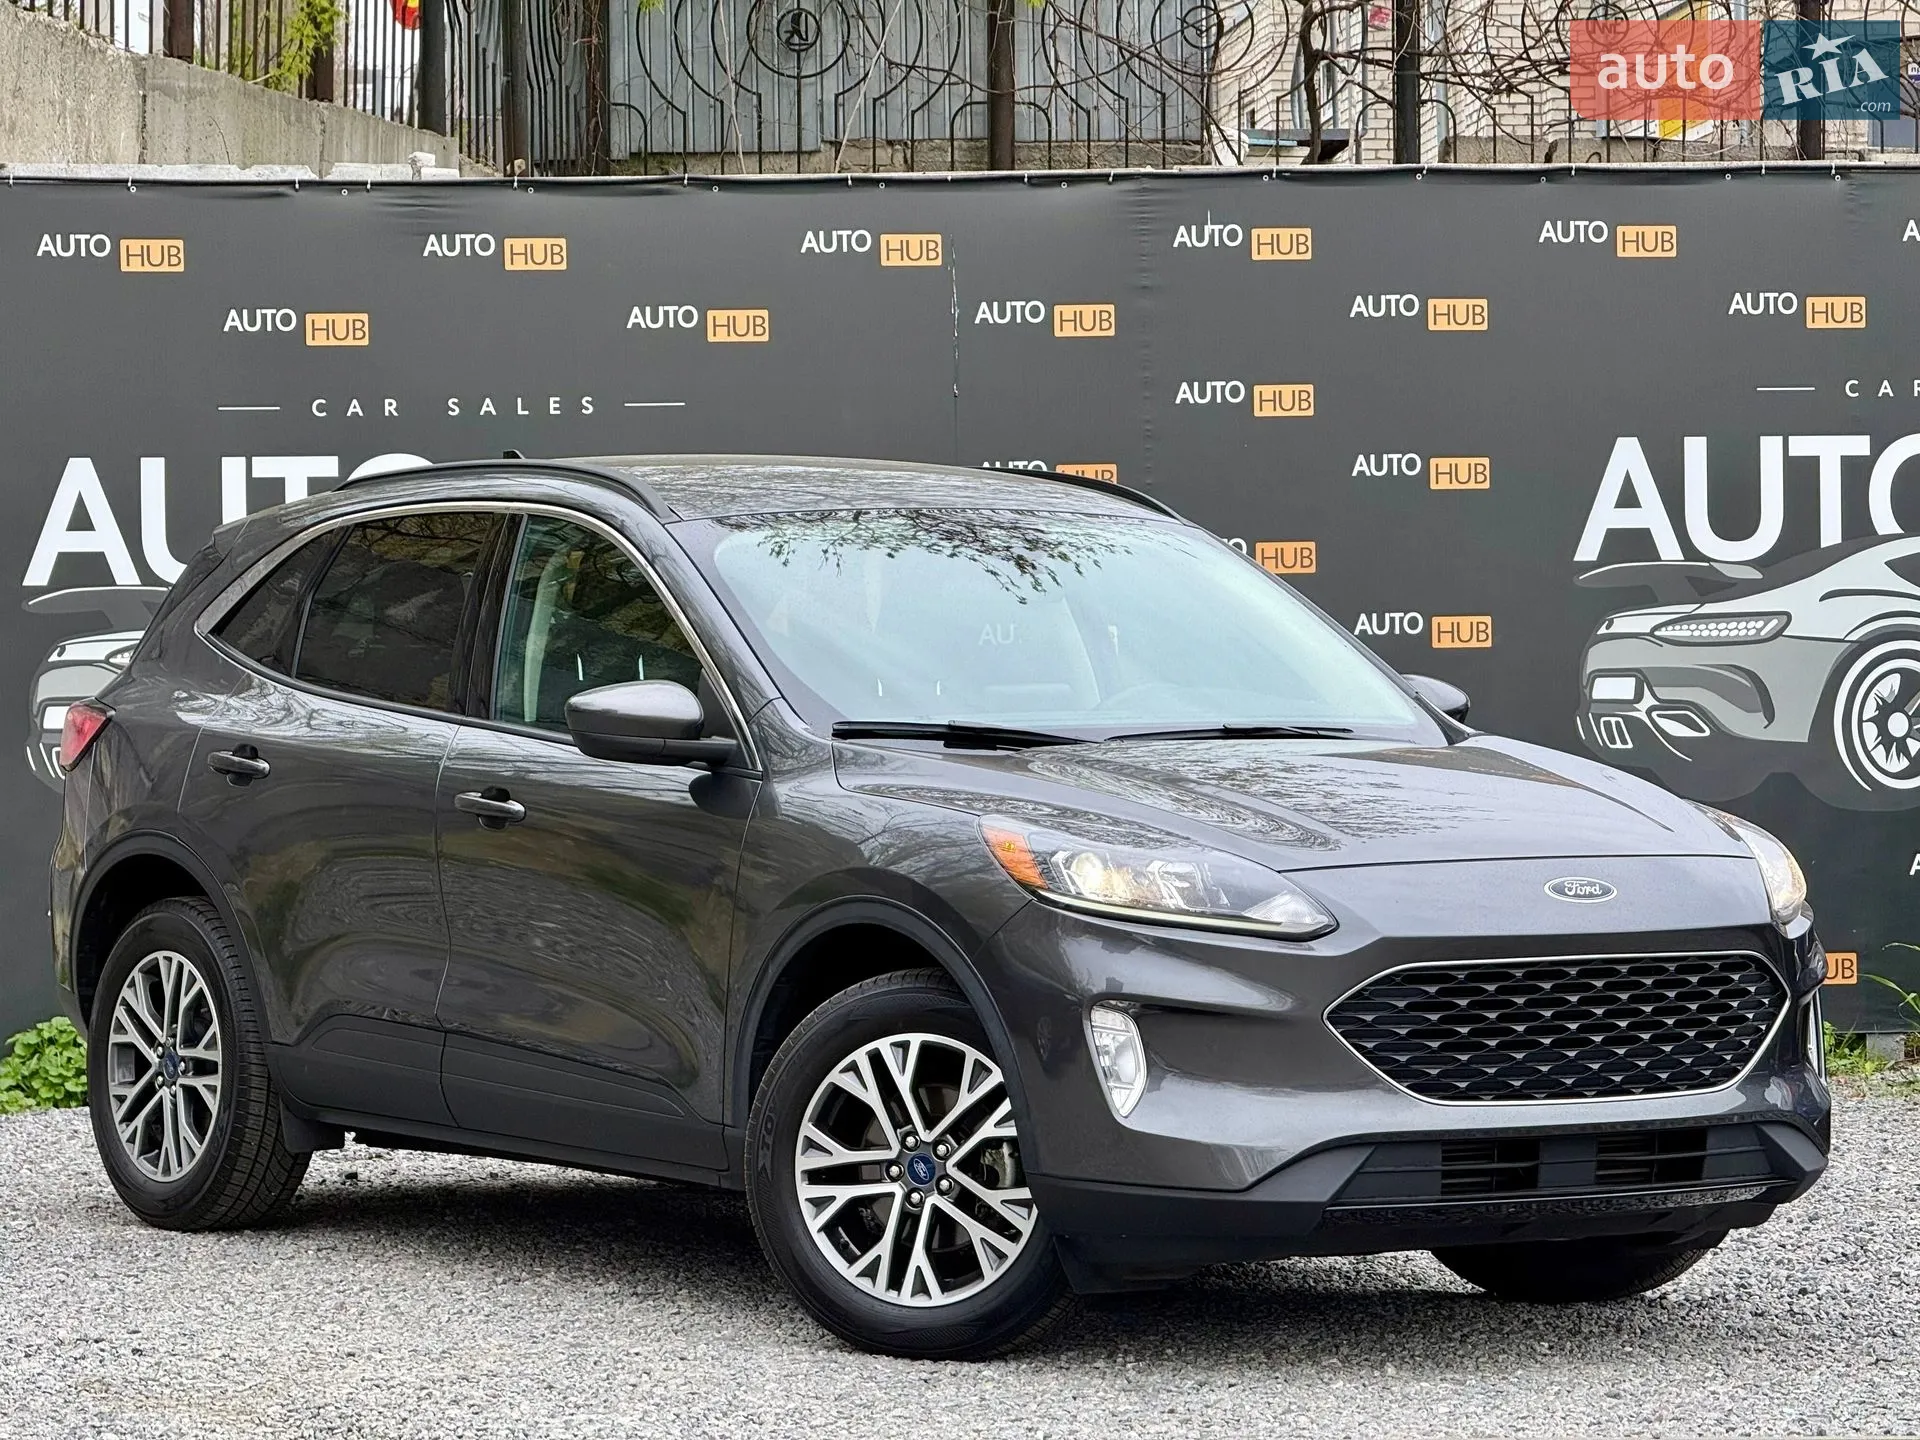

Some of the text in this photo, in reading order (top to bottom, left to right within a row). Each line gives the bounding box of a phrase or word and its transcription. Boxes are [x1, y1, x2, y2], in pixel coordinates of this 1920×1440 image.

[37, 234, 182, 267] AUTO HUB
[423, 234, 564, 266] AUTO HUB
[801, 230, 939, 262] AUTO HUB
[1173, 225, 1309, 256] AUTO HUB
[1539, 221, 1674, 253] AUTO HUB
[627, 305, 766, 338] AUTO HUB
[975, 301, 1112, 332] AUTO HUB
[1350, 294, 1485, 326] AUTO HUB
[1728, 292, 1863, 324] AUTO HUB
[224, 309, 366, 341] AUTO HUB
[312, 396, 594, 416] CAR SALES
[1175, 381, 1311, 412] AUTO HUB
[1352, 453, 1487, 485] AUTO HUB
[1261, 547, 1313, 569] HUB
[1354, 612, 1489, 643] AUTO HUB
[1564, 880, 1602, 895] Ford
[1825, 958, 1854, 979] UB
